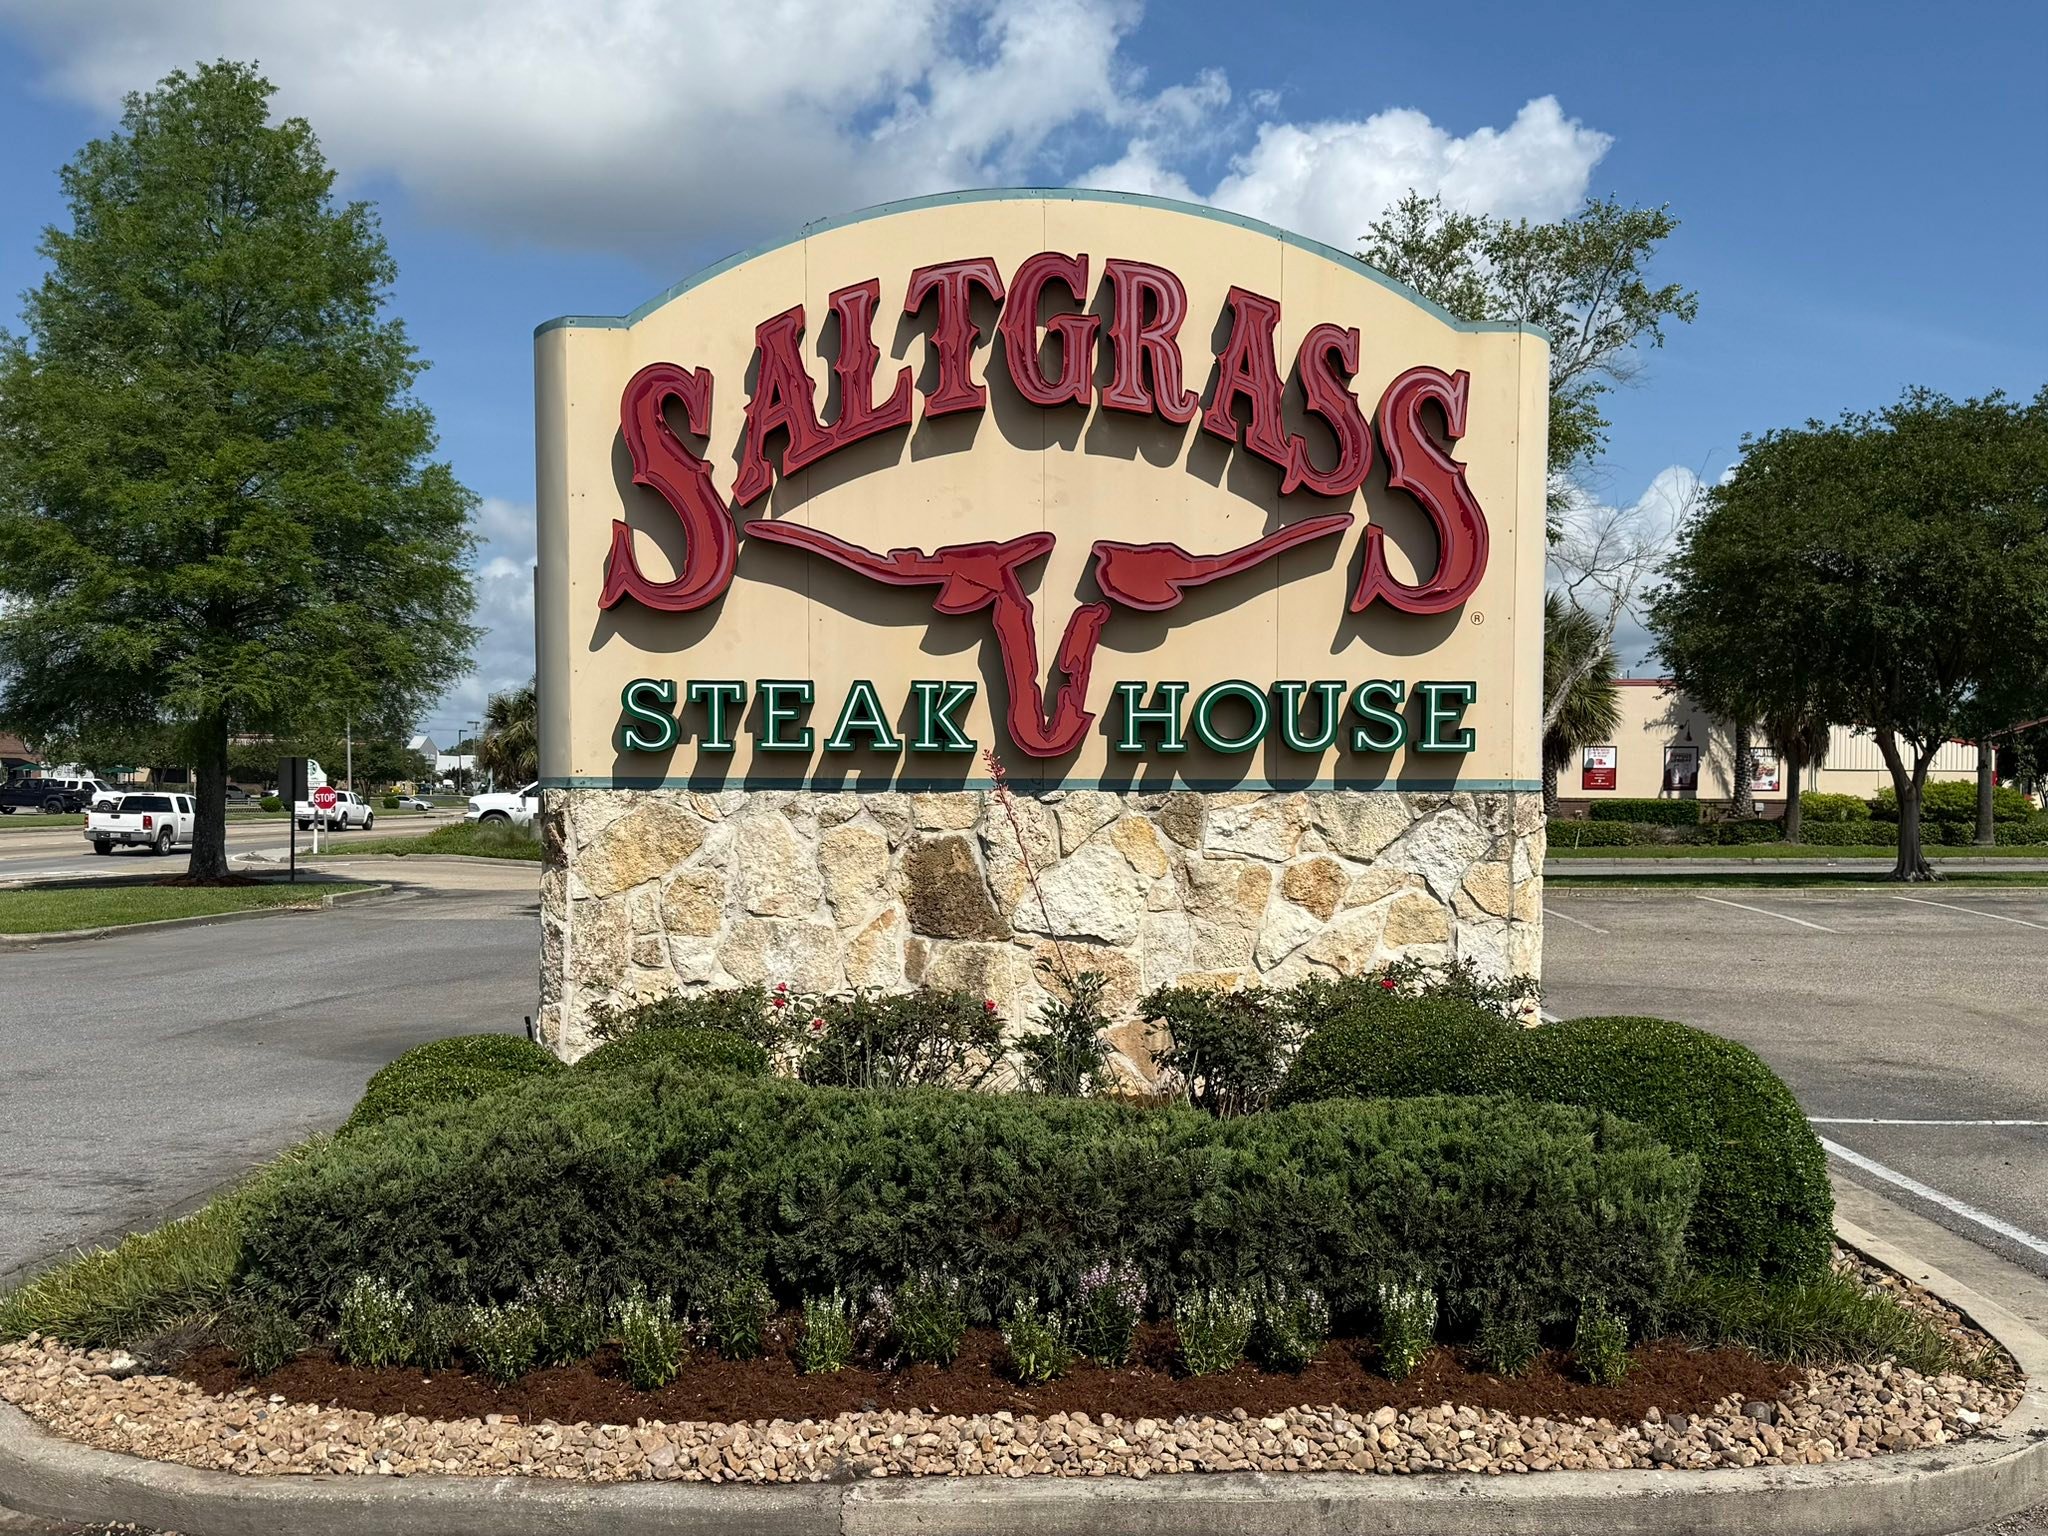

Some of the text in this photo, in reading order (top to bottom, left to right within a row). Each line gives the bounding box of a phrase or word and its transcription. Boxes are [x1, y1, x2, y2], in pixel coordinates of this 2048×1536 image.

[600, 252, 1490, 615] SALTGRASS
[621, 678, 1477, 753] STEAK HOUSE
[315, 793, 336, 803] STOP
